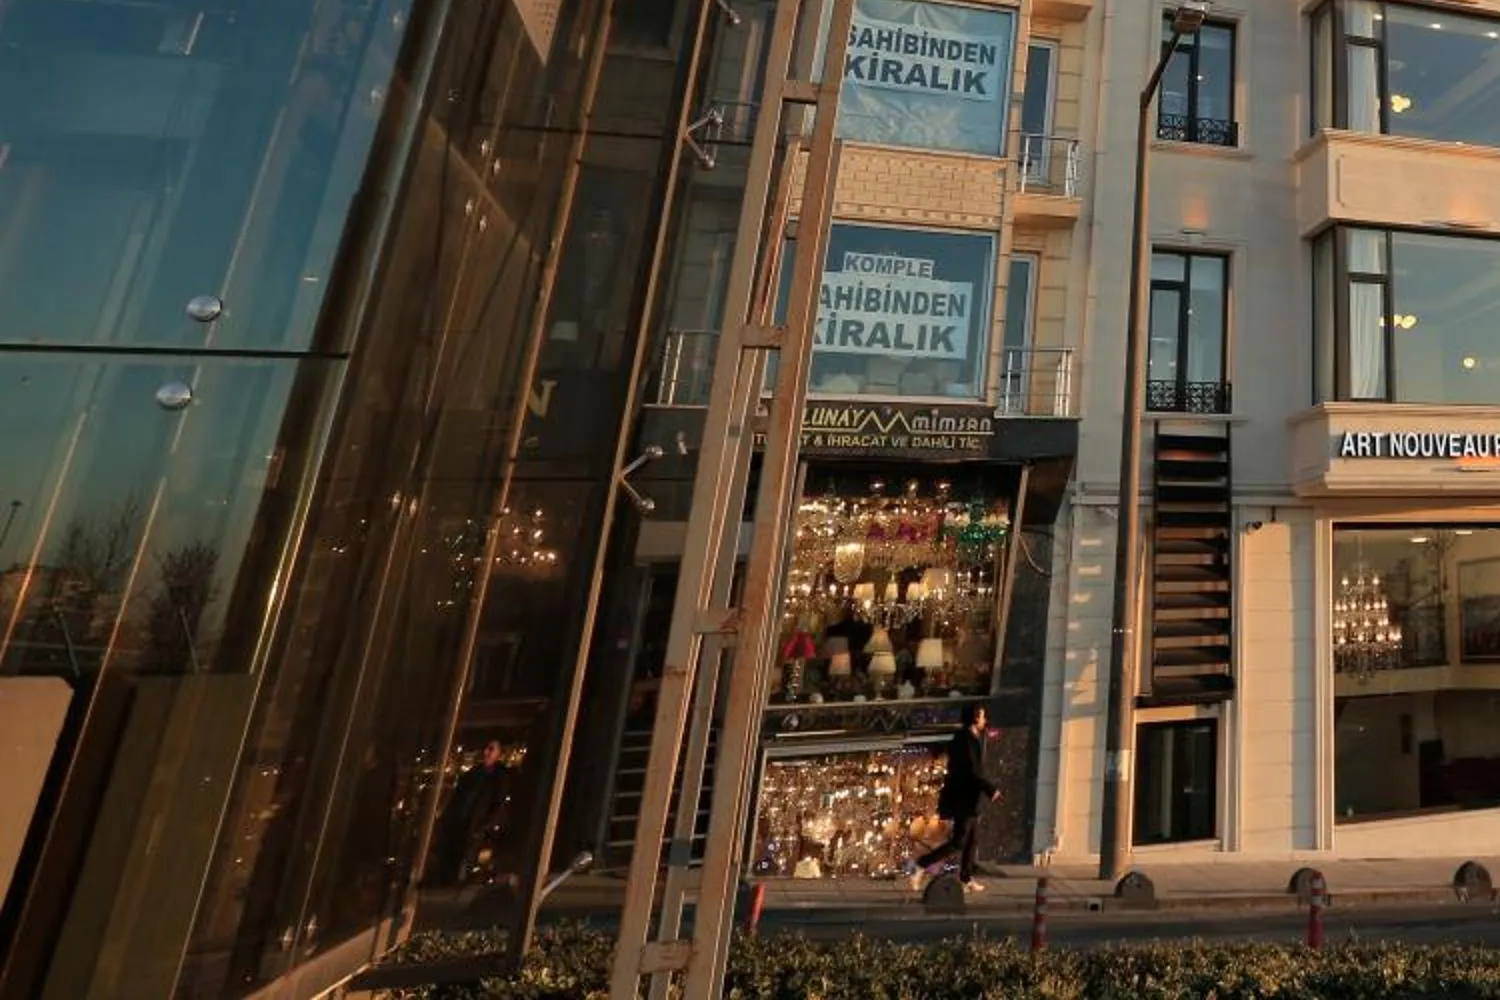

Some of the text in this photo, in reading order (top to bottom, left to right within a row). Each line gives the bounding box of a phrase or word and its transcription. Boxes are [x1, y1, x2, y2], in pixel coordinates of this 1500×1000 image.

[844, 51, 989, 96] KİRALIK
[845, 254, 933, 279] KOMPLE
[819, 280, 967, 318] AHİBİNDEN
[1341, 431, 1385, 457] ART
[1389, 431, 1490, 458] NOUVEAU
